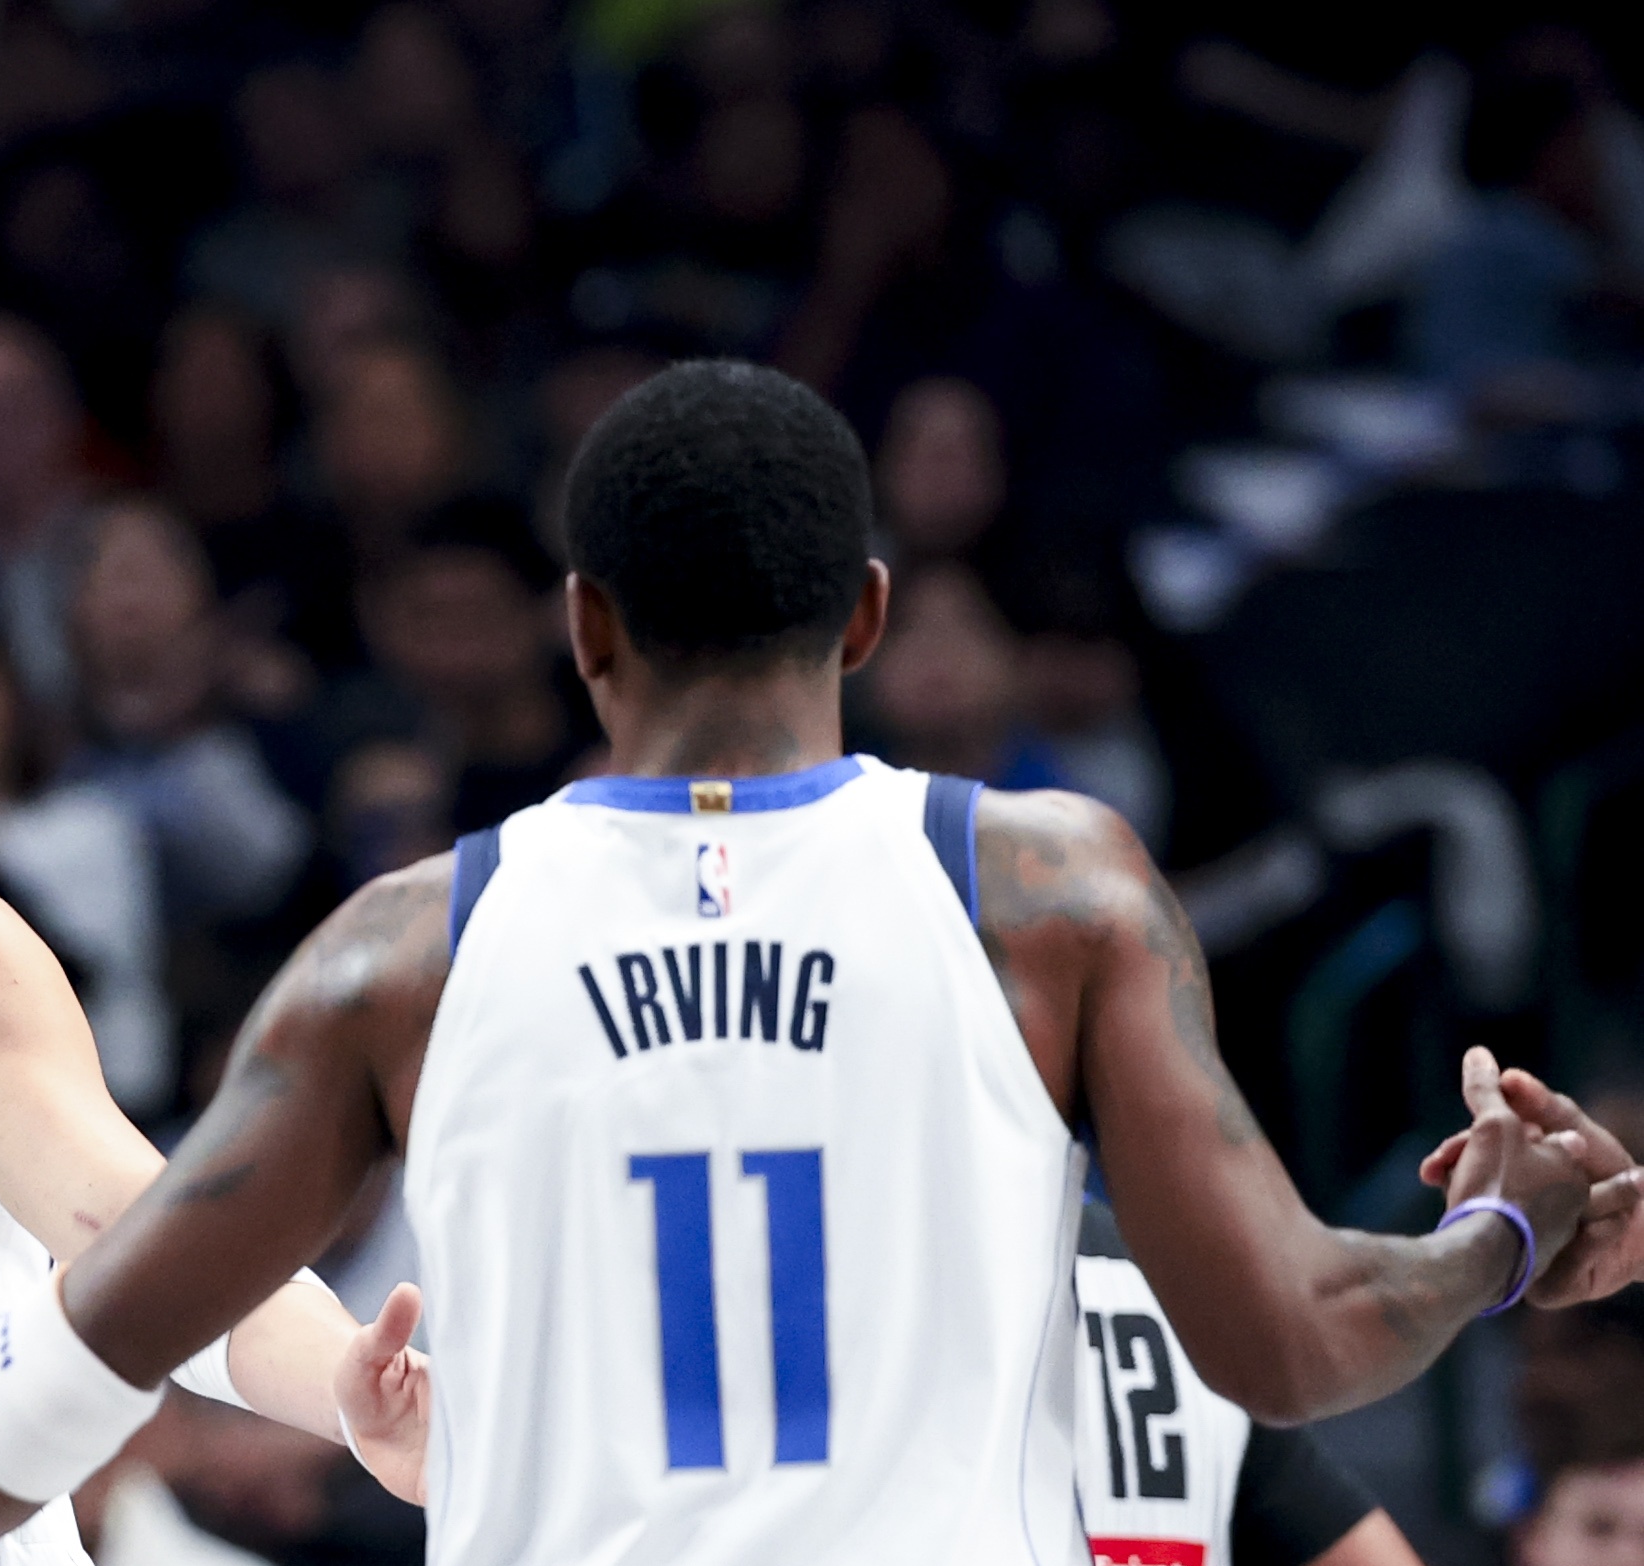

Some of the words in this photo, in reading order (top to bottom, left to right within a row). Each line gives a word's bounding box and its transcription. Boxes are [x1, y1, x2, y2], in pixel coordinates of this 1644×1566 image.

[578, 941, 836, 1060] IRVING
[625, 1146, 831, 1473] 11
[1085, 1311, 1188, 1500] 12
